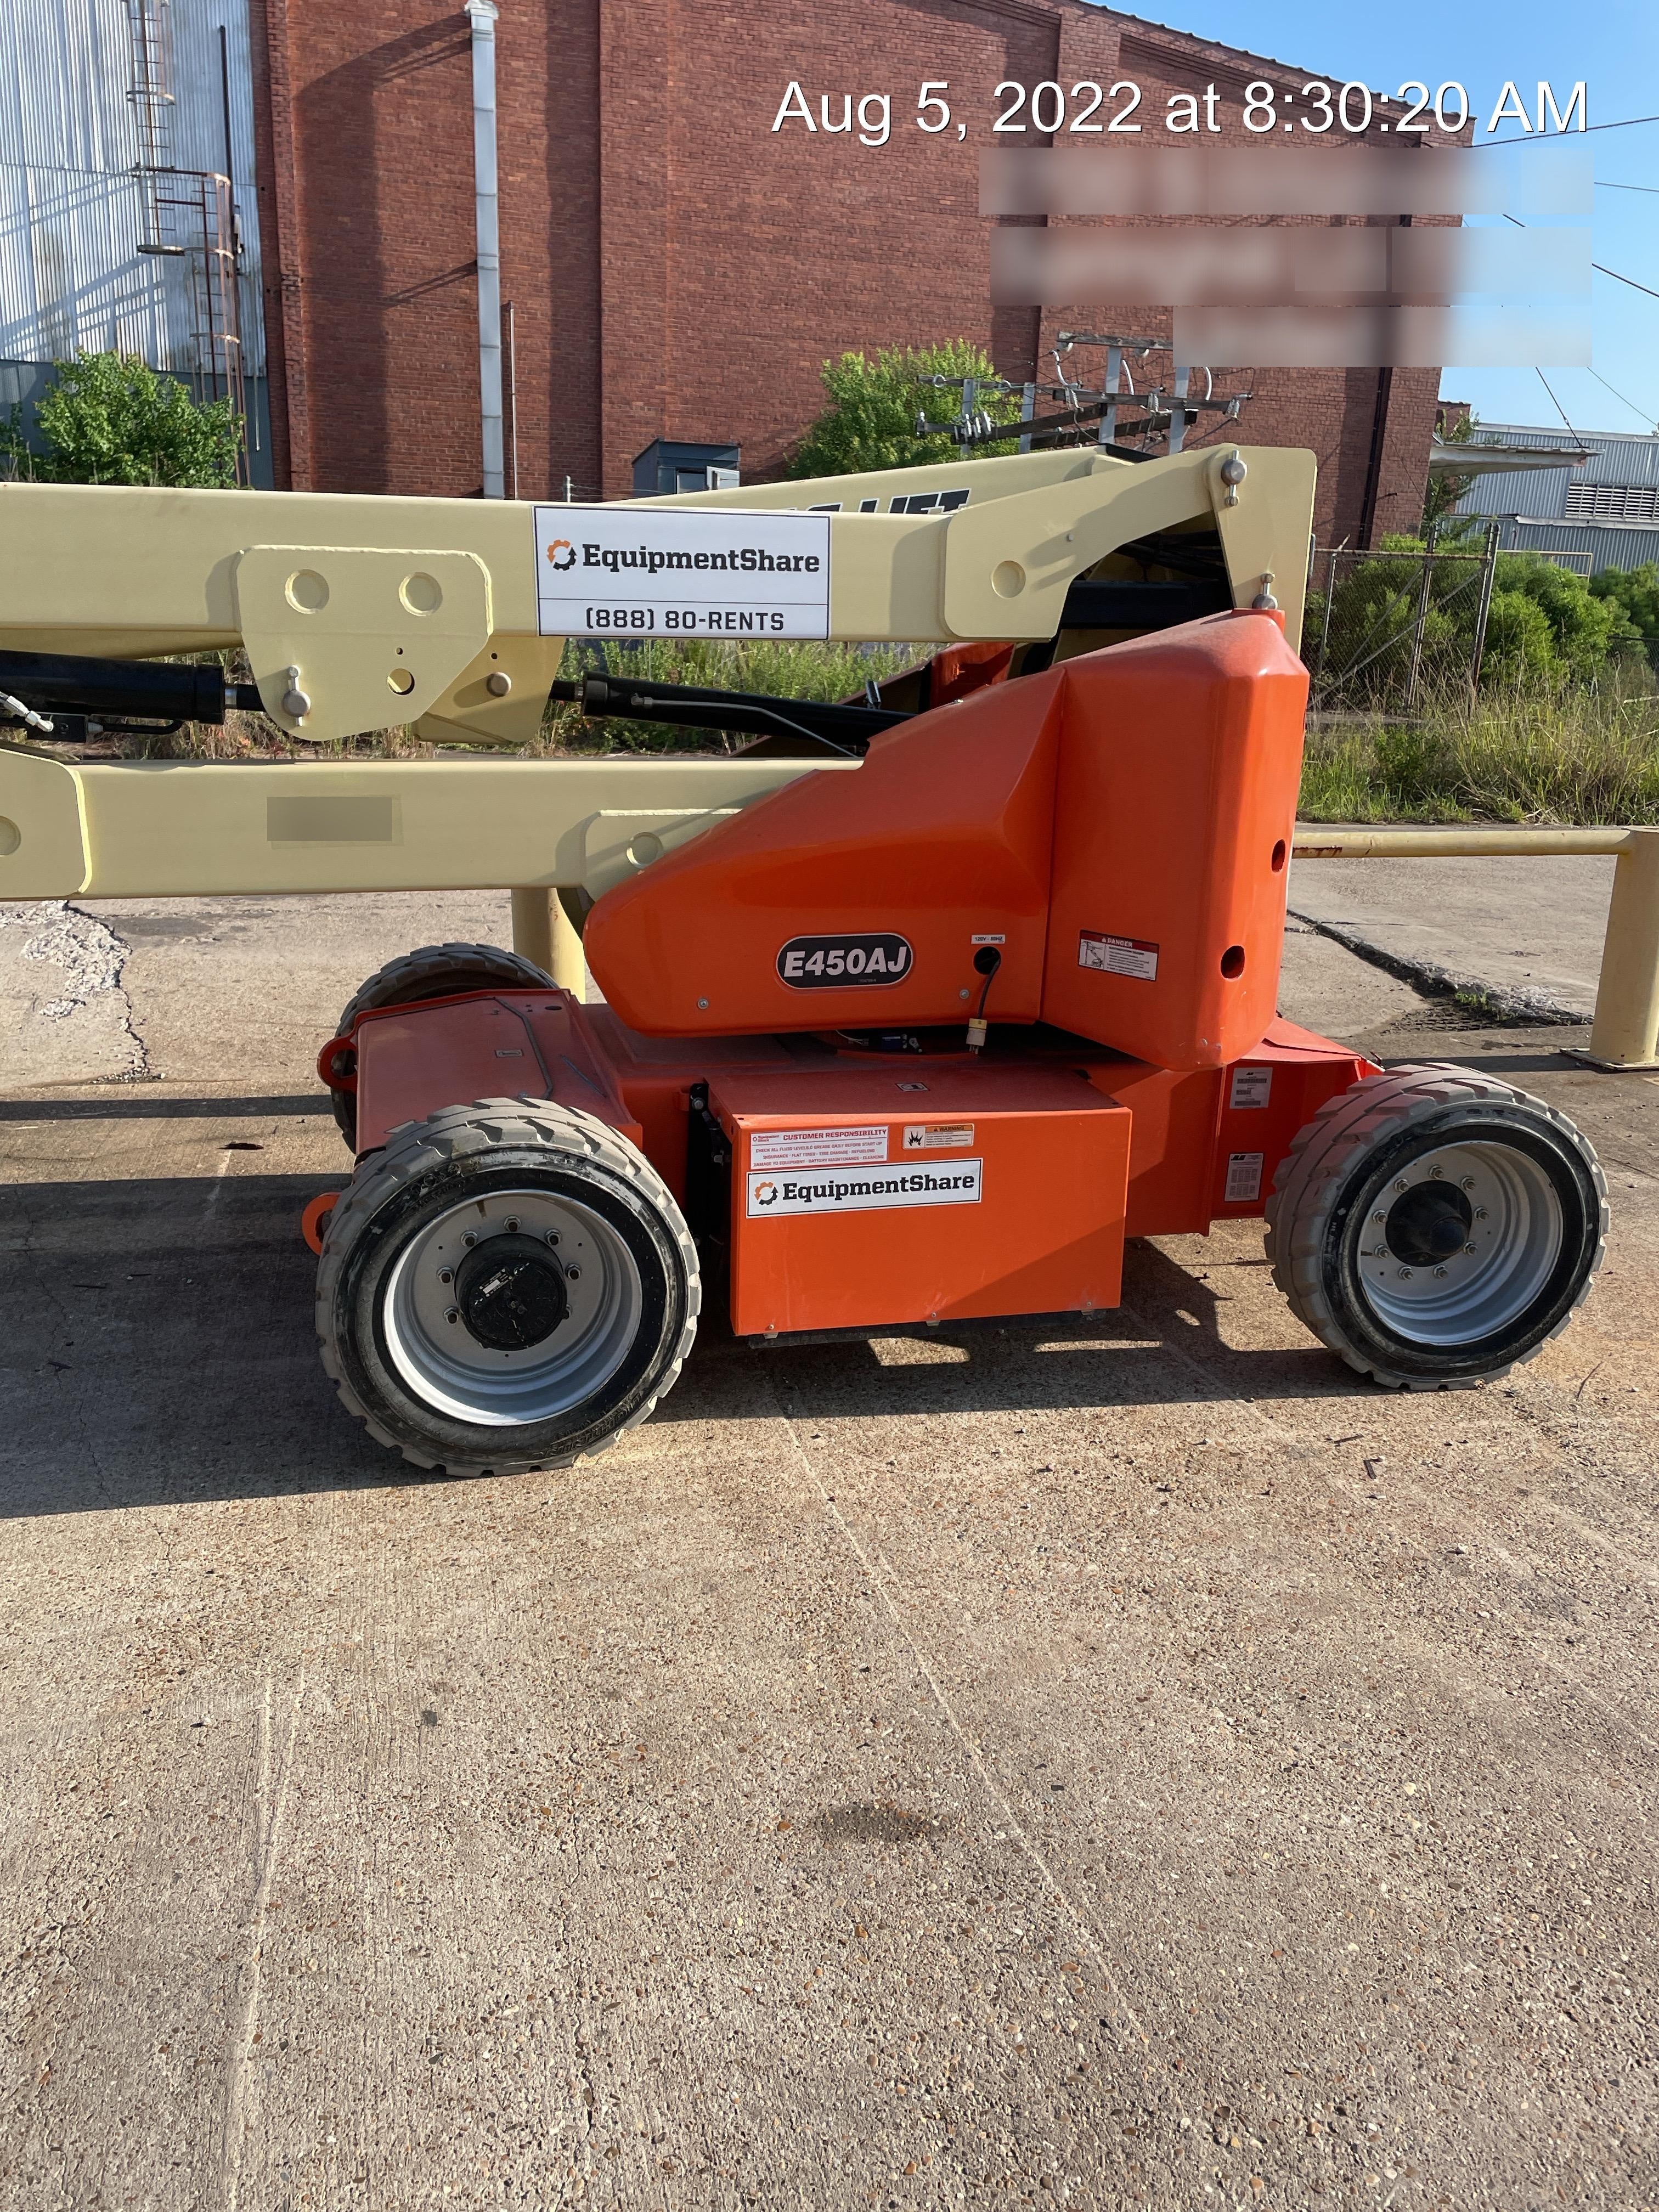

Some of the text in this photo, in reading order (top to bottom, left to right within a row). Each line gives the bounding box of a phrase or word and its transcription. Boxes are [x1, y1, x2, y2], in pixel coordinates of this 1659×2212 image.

[582, 544, 820, 573] EquipmentShare
[586, 607, 784, 631] (888) 80-RENTS
[1107, 938, 1133, 948] DANGER
[784, 946, 907, 977] E450AJ
[826, 1129, 887, 1138] RESPONSIBILITY
[782, 1175, 974, 1203] EquipmentShare
